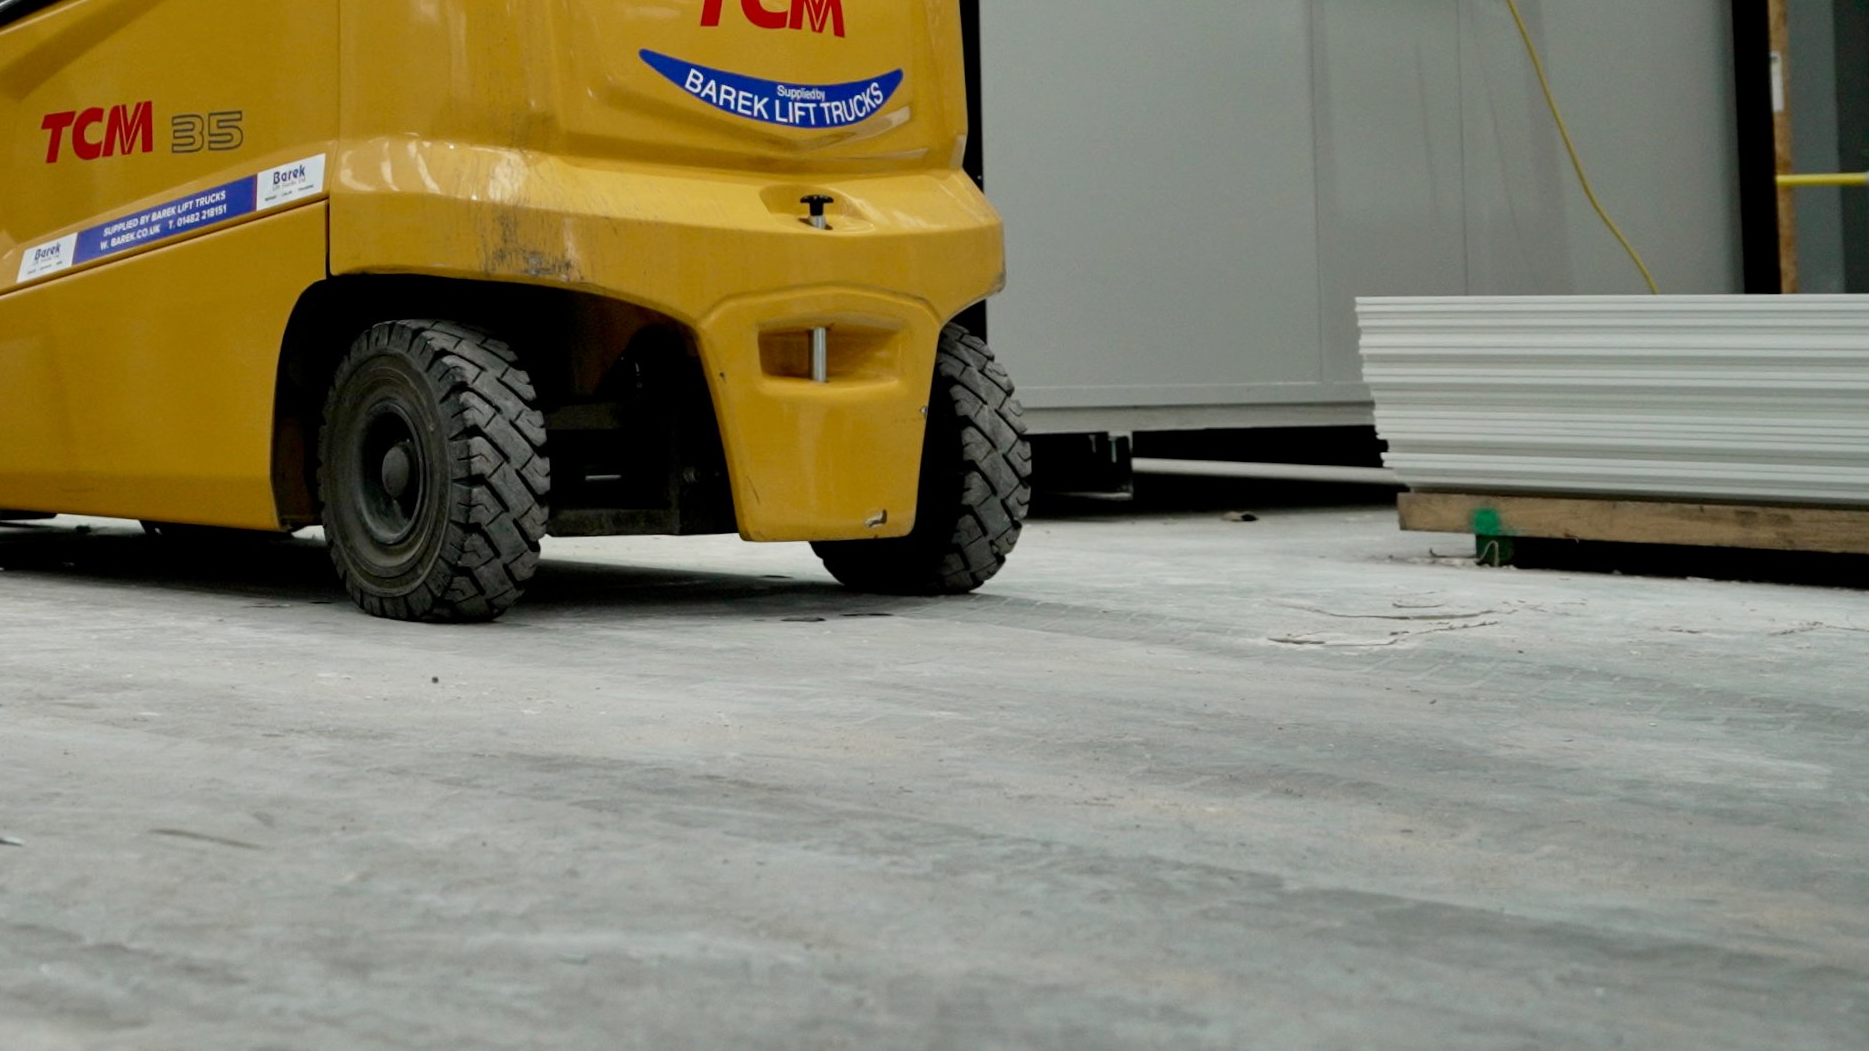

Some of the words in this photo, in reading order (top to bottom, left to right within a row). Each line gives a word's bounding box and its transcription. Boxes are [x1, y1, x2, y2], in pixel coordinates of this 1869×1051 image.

[684, 68, 769, 120] BAREK
[775, 99, 818, 125] LIFT
[819, 82, 884, 125] TRUCKS
[41, 101, 153, 163] TCM
[171, 110, 244, 153] 35
[273, 164, 305, 185] Barek
[103, 217, 139, 237] SUPPLIED
[139, 213, 151, 226] BY
[151, 205, 177, 222] BAREK
[177, 200, 193, 214] LIFT
[195, 190, 226, 208] TRUCKS
[110, 224, 161, 247] BAREK.CO.UK
[177, 213, 200, 228] 01482
[34, 242, 61, 261] Barek
